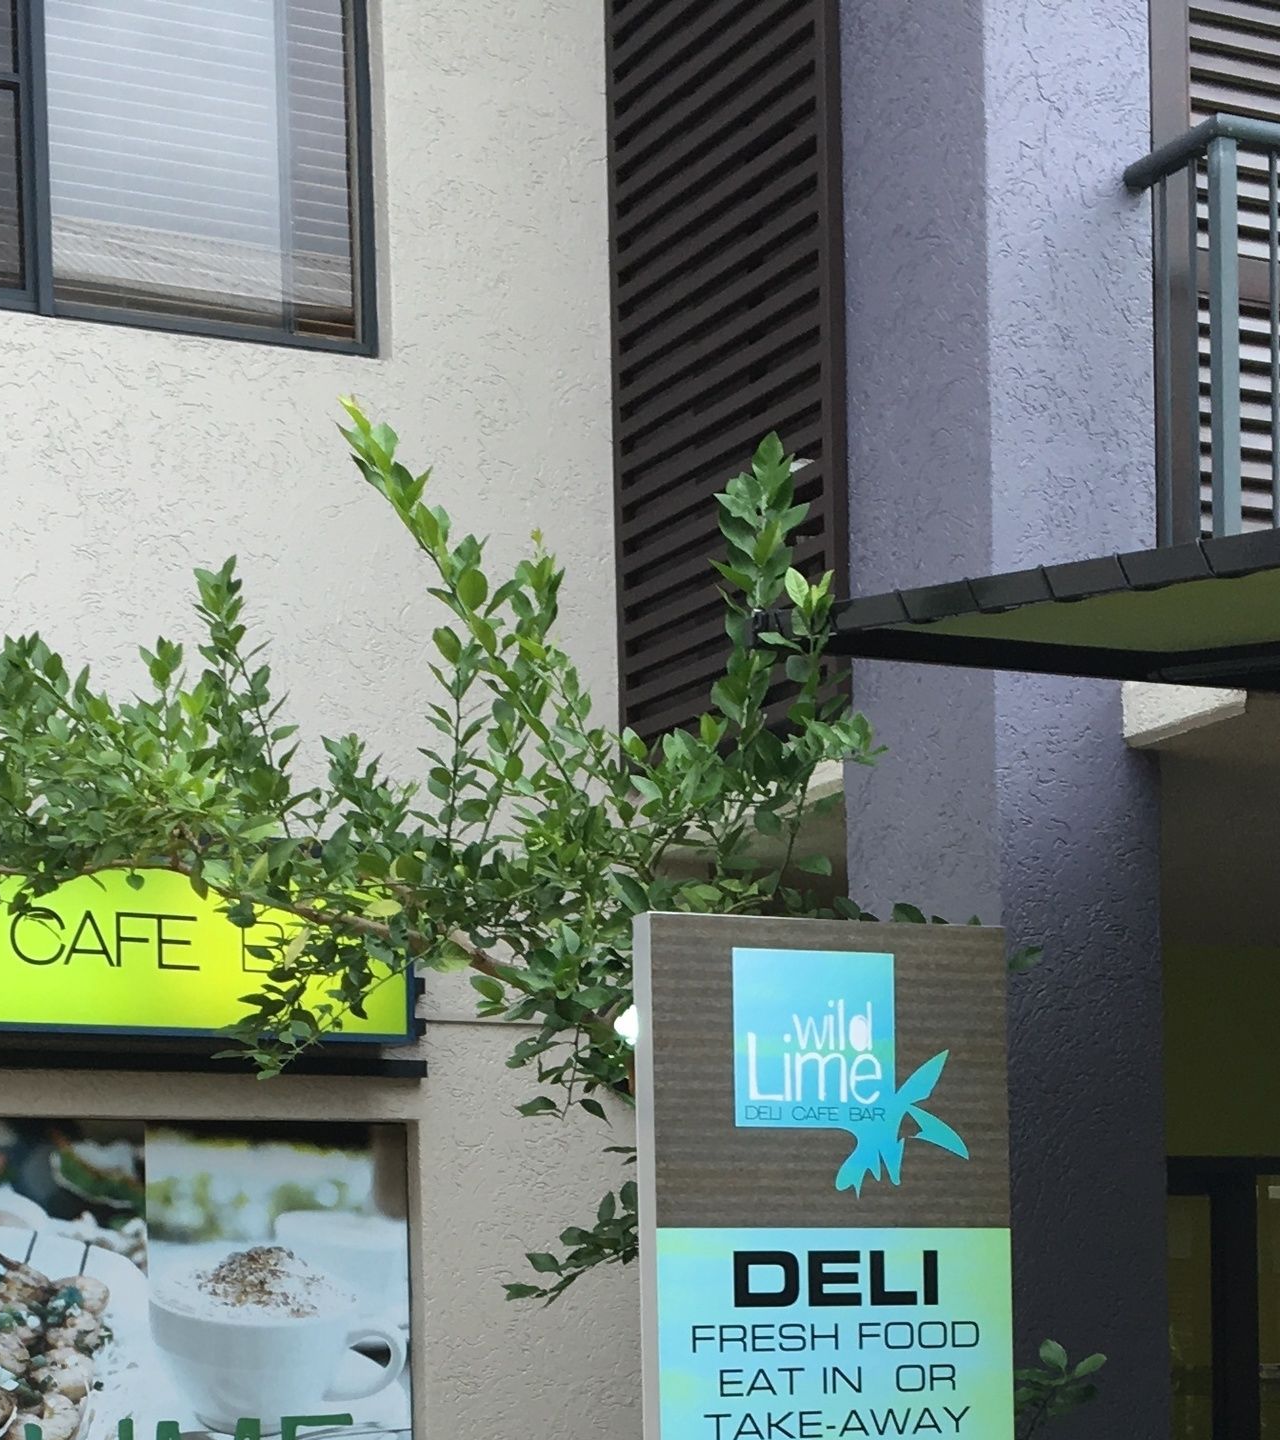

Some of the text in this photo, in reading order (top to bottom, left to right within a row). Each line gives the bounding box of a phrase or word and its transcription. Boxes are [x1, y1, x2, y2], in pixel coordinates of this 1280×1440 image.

[10, 906, 201, 972] CAFE
[792, 998, 873, 1051] wild
[747, 1032, 882, 1104] Lime
[745, 1105, 886, 1122] DELI CAFE BAR
[732, 1249, 939, 1308] DELI
[692, 1320, 980, 1353] FRESH FOOD
[719, 1363, 956, 1397] EAT IN OR
